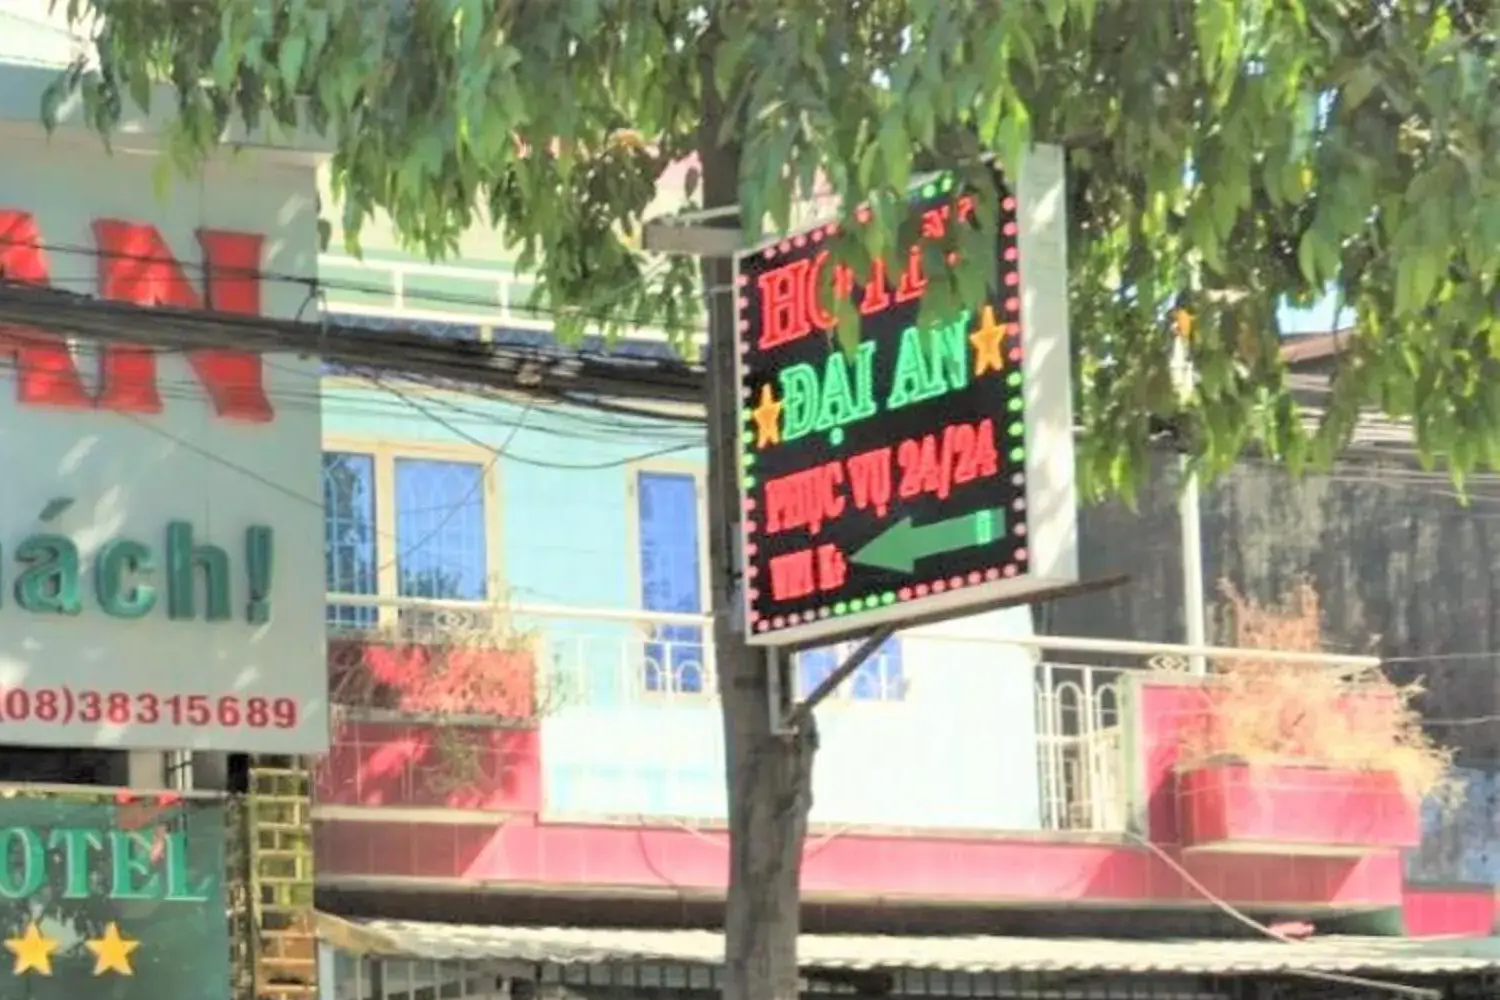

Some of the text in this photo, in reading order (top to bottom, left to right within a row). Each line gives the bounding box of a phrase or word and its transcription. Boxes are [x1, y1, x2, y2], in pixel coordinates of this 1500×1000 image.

[780, 310, 972, 445] ĐẠI AN
[847, 447, 892, 518] VỤ
[897, 418, 998, 500] 24/24
